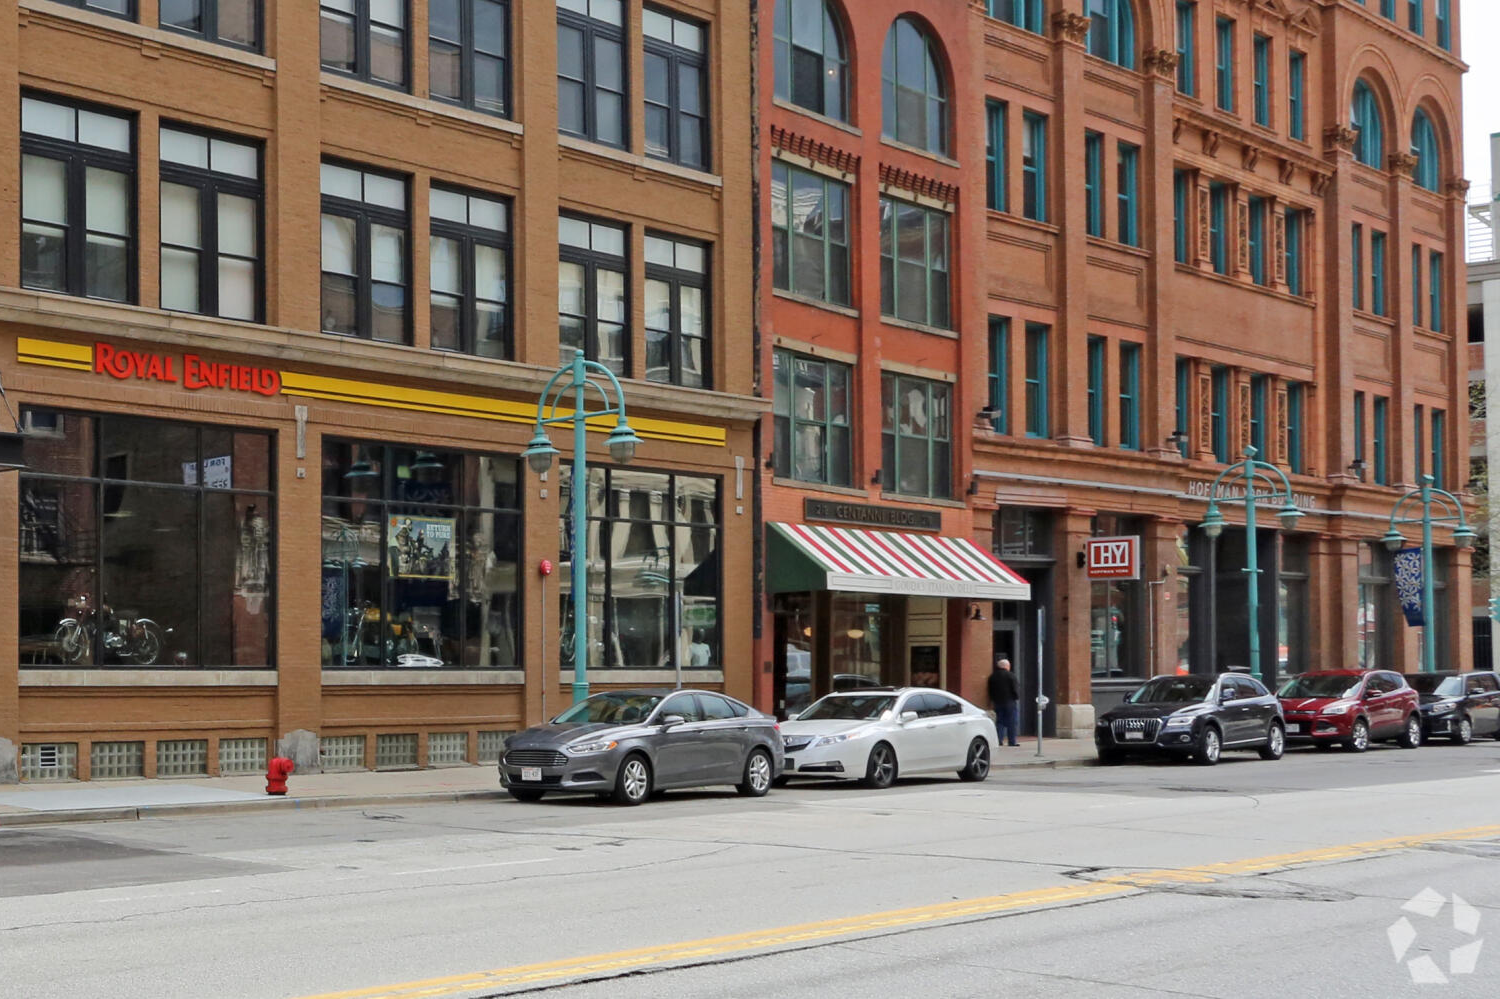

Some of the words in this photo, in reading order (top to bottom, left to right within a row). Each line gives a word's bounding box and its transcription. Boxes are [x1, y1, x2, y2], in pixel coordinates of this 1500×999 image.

[95, 342, 178, 382] ROYAL
[183, 354, 280, 396] ENFIELD
[1188, 481, 1239, 500] HOFMAN
[1271, 492, 1316, 509] BUDING
